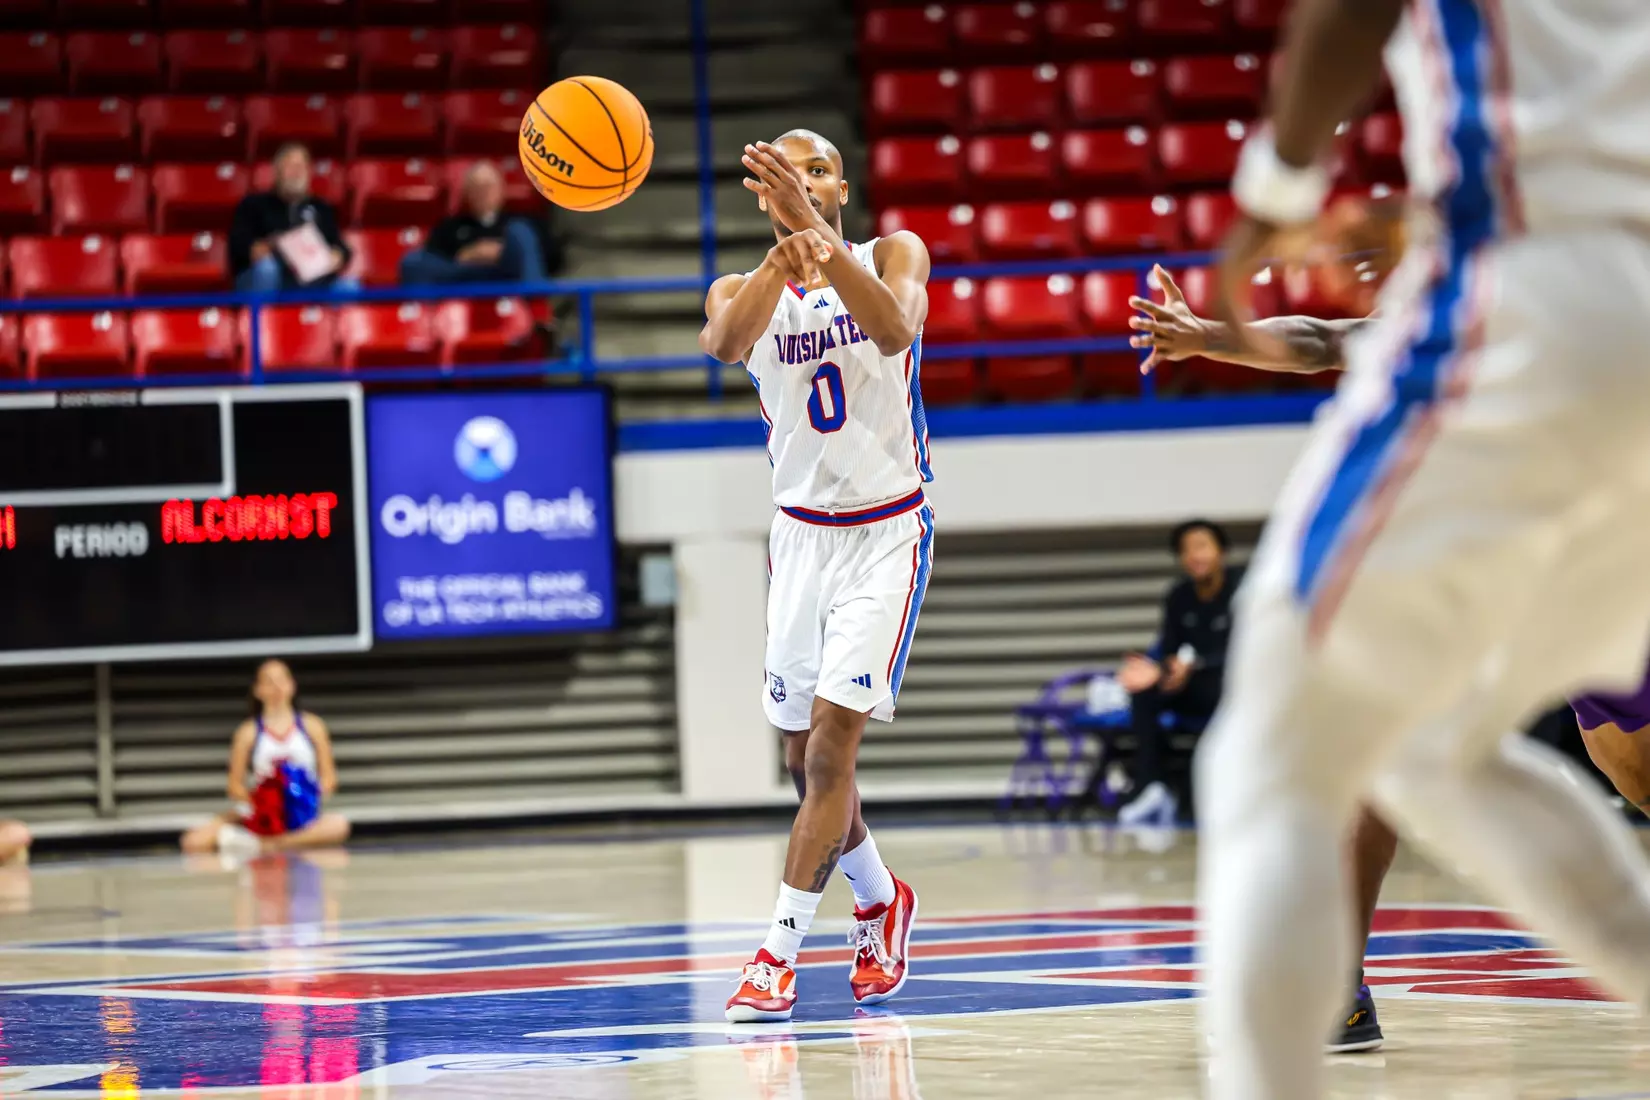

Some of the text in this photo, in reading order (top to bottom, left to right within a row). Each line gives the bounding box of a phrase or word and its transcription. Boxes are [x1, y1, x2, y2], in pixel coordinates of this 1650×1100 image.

[522, 112, 575, 178] Wilson
[807, 361, 847, 434] 0
[55, 522, 149, 558] PERIOD
[381, 487, 595, 544] Origin Bank
